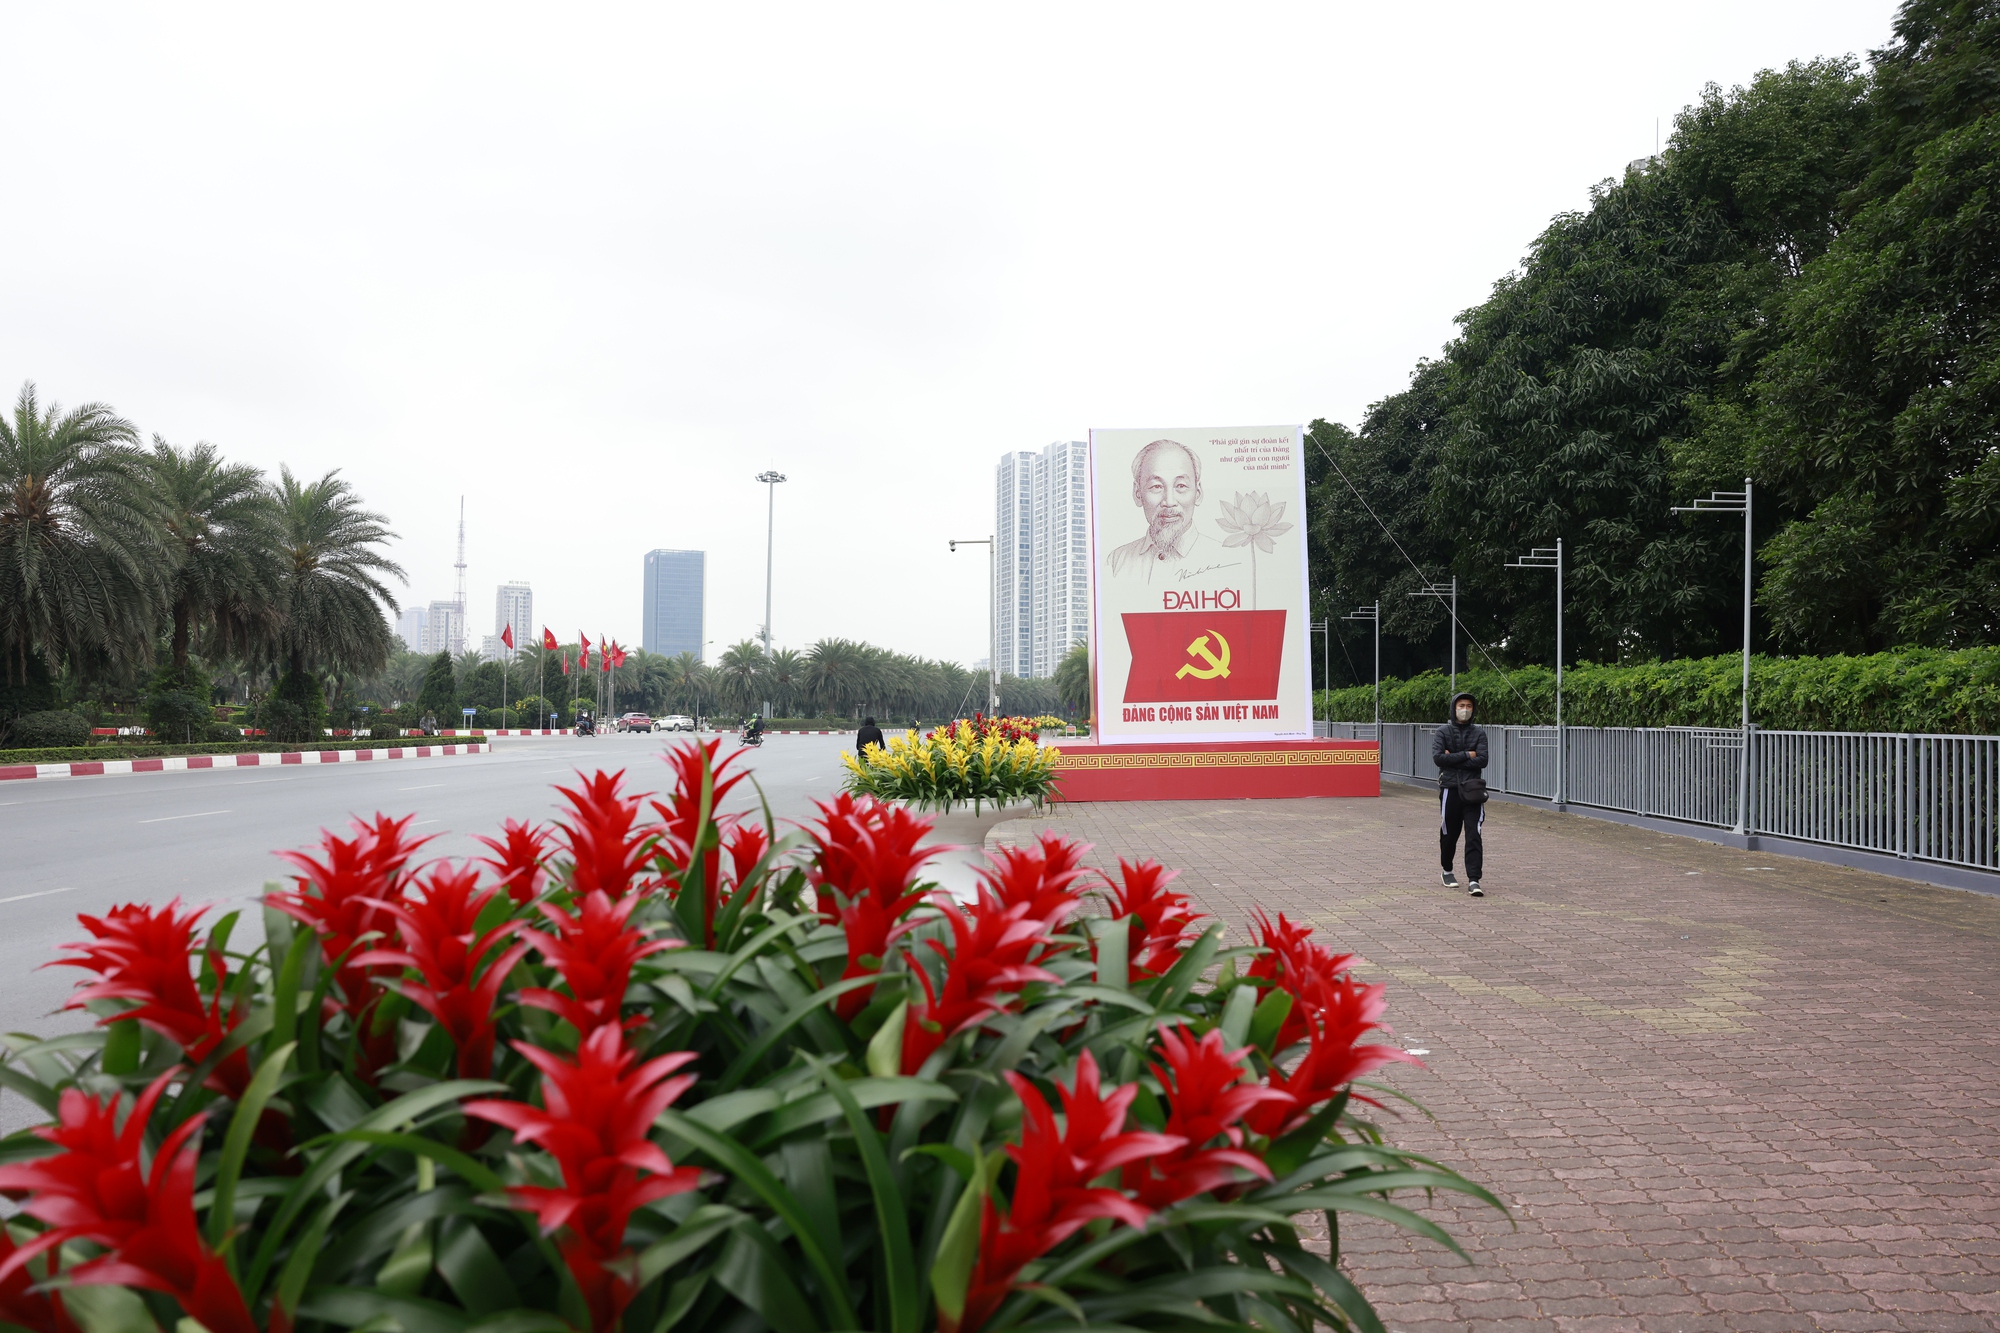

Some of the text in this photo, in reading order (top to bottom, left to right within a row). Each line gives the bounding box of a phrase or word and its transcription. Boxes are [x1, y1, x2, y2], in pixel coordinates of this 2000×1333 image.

[1162, 587, 1240, 610] ĐẠI HỘI
[1122, 703, 1279, 724] ĐẢNG CỘNG SẢN VIỆT NAM
